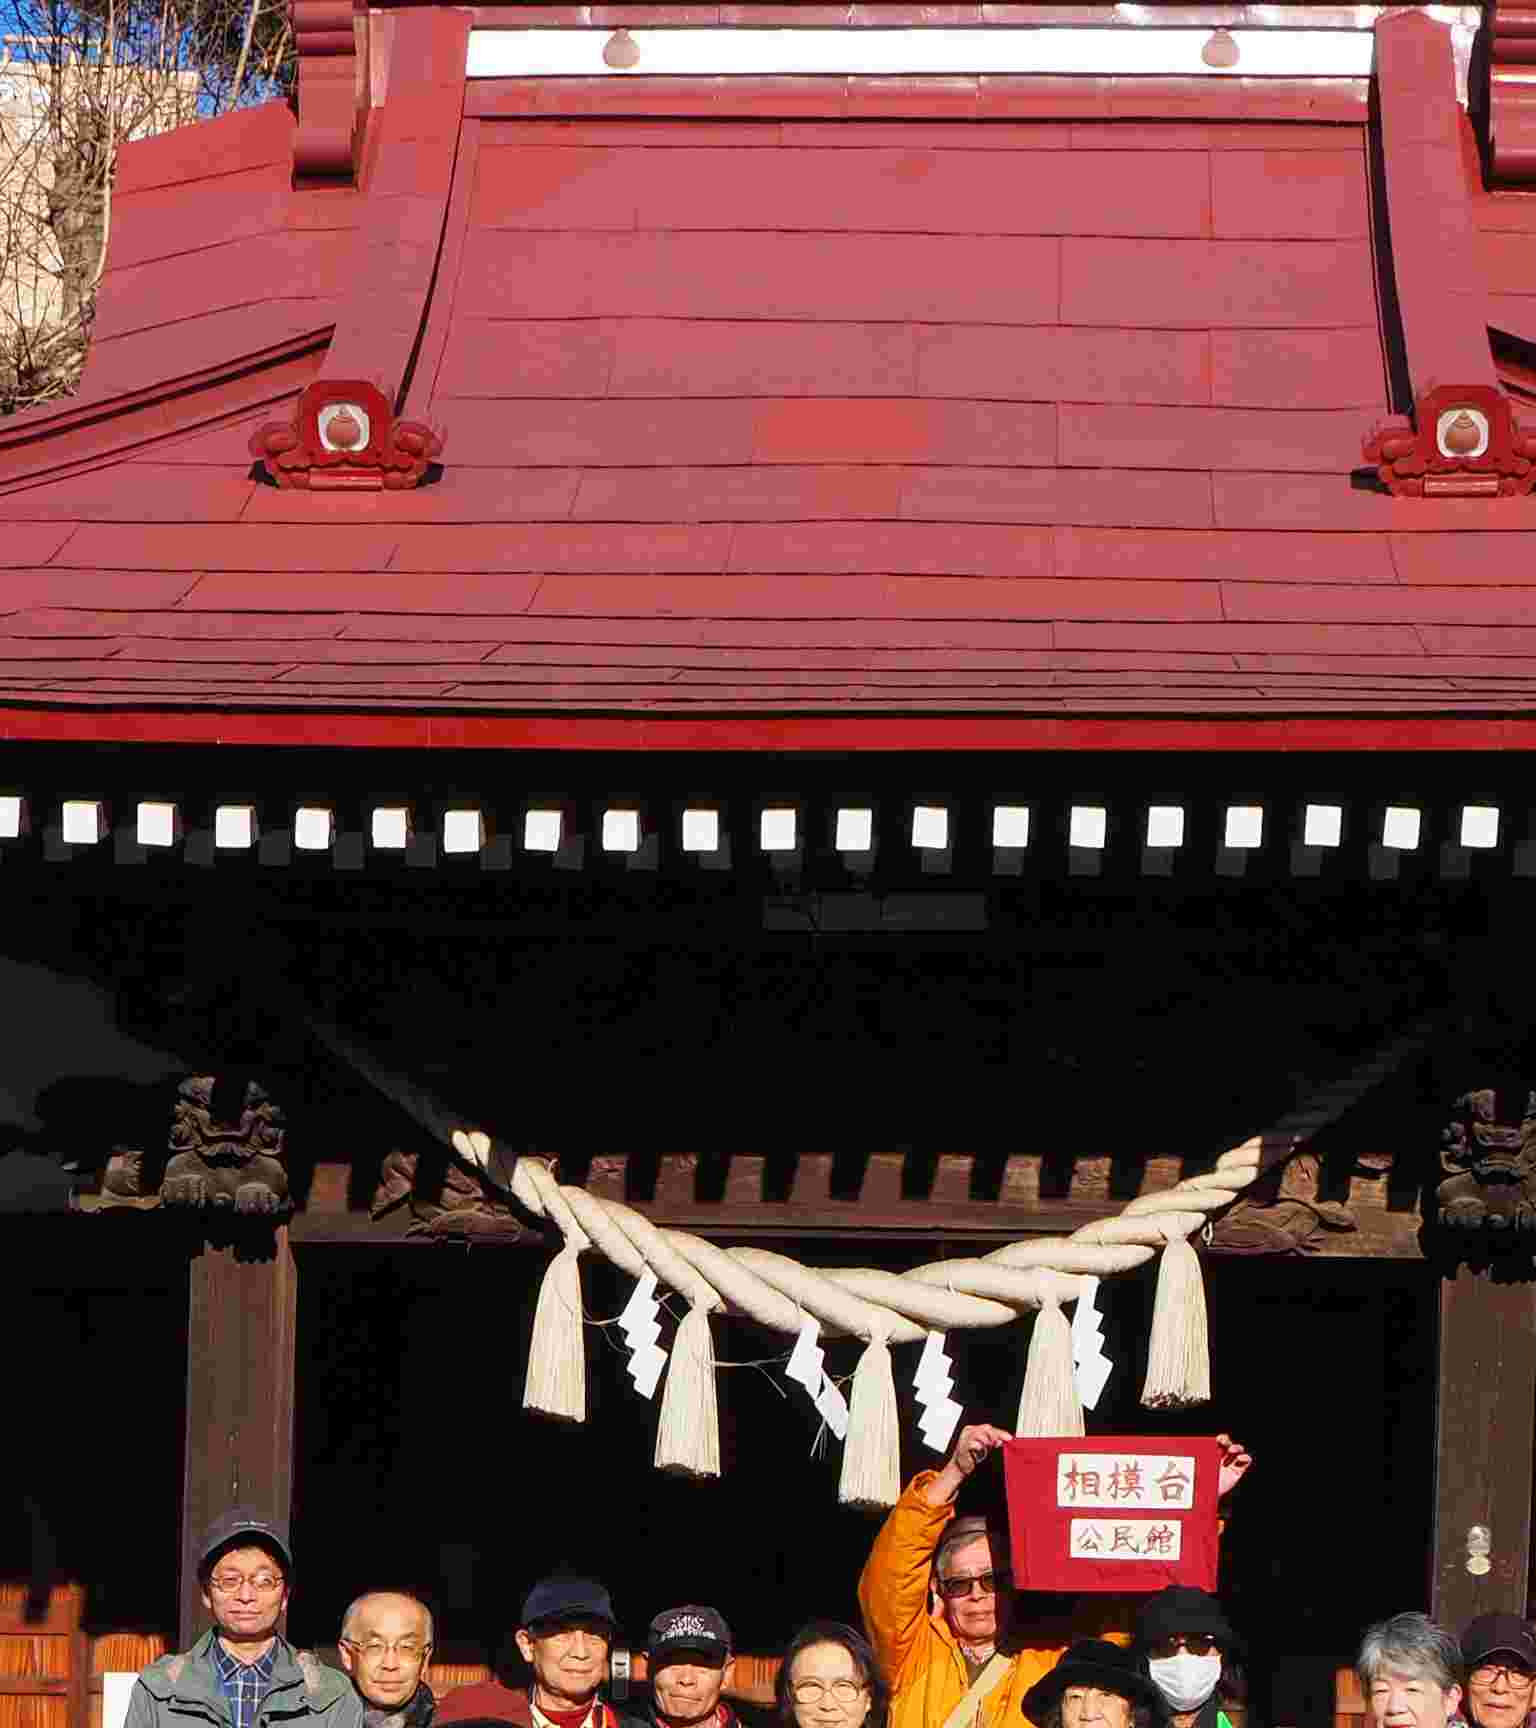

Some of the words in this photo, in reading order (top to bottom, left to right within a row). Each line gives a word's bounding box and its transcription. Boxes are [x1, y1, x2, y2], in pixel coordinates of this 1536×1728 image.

[1064, 1460, 1191, 1502] 相模台
[1076, 1523, 1175, 1555] 公民館
